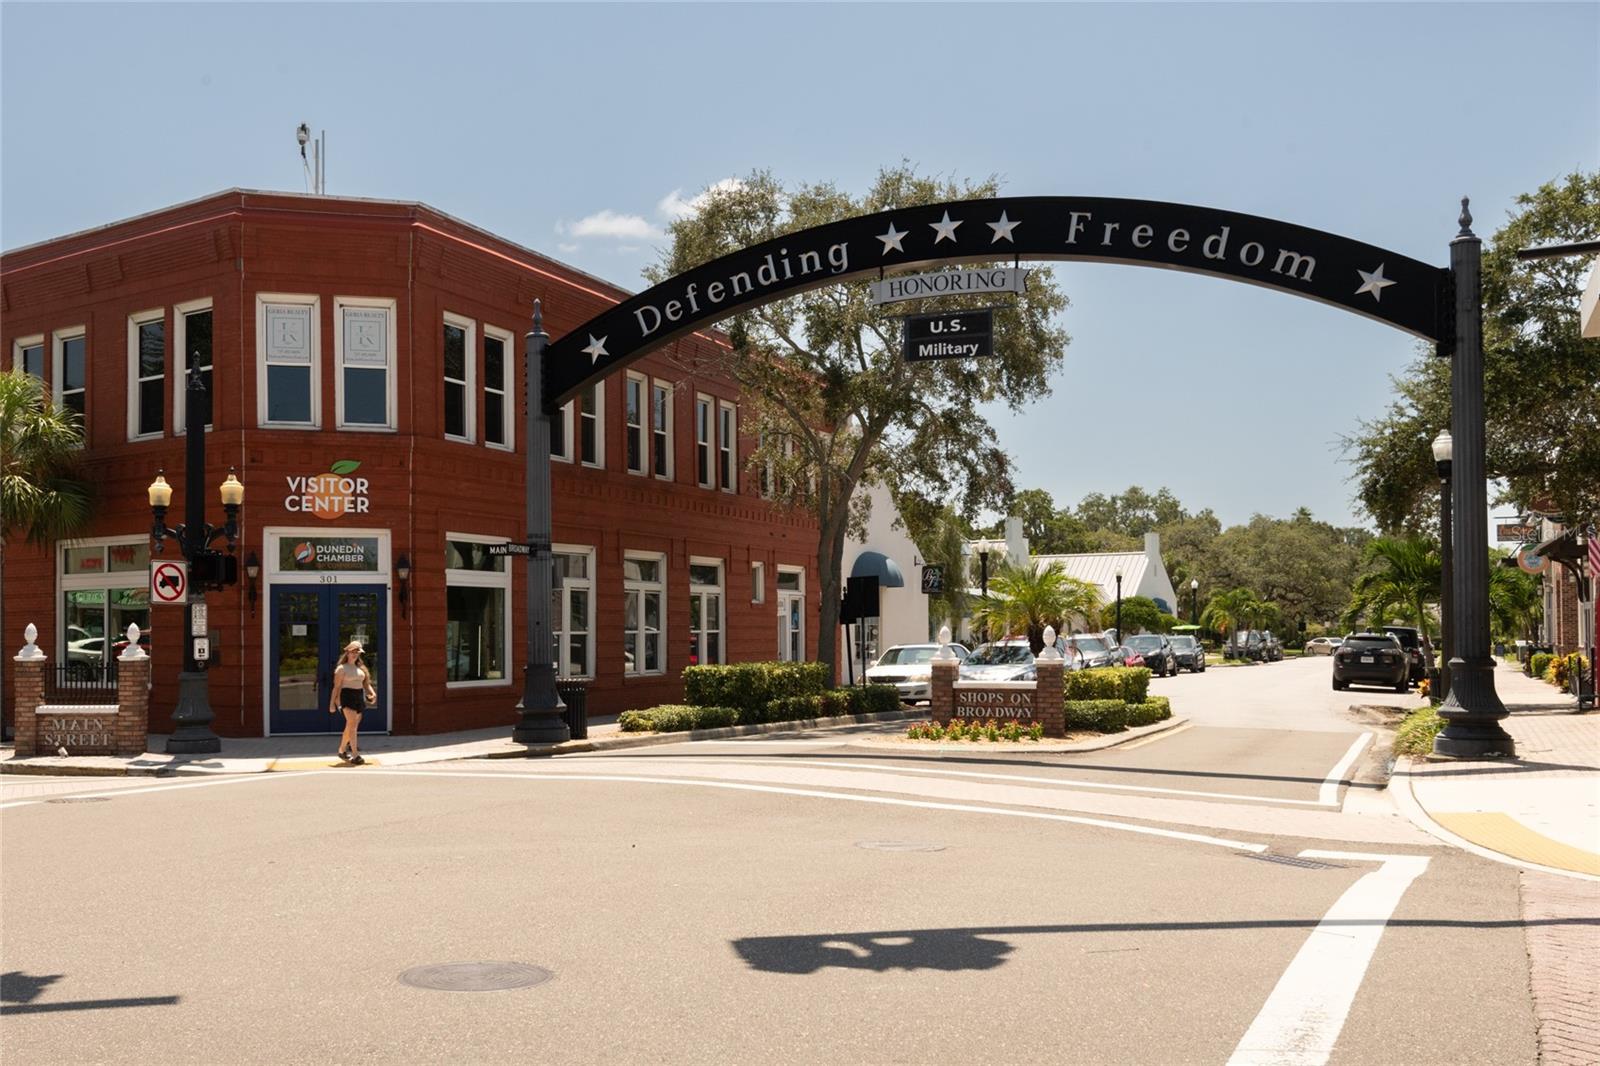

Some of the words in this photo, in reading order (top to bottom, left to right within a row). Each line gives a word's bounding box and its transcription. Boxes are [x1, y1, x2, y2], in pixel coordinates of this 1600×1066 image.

[633, 242, 849, 337] Defending
[1065, 212, 1316, 282] Freedom
[890, 271, 1006, 297] HONORING
[930, 319, 967, 333] U.S.
[919, 343, 979, 357] Military
[286, 476, 369, 494] VISITOR
[285, 495, 369, 513] CENTER
[489, 546, 507, 554] MAIN
[316, 554, 364, 562] CHAMBER
[320, 575, 338, 583] 301
[960, 692, 1004, 703] SHOPS
[1010, 692, 1032, 705] ON
[957, 706, 1033, 718] BROADWAY
[52, 718, 104, 731] MAIN
[44, 733, 112, 746] STREET
